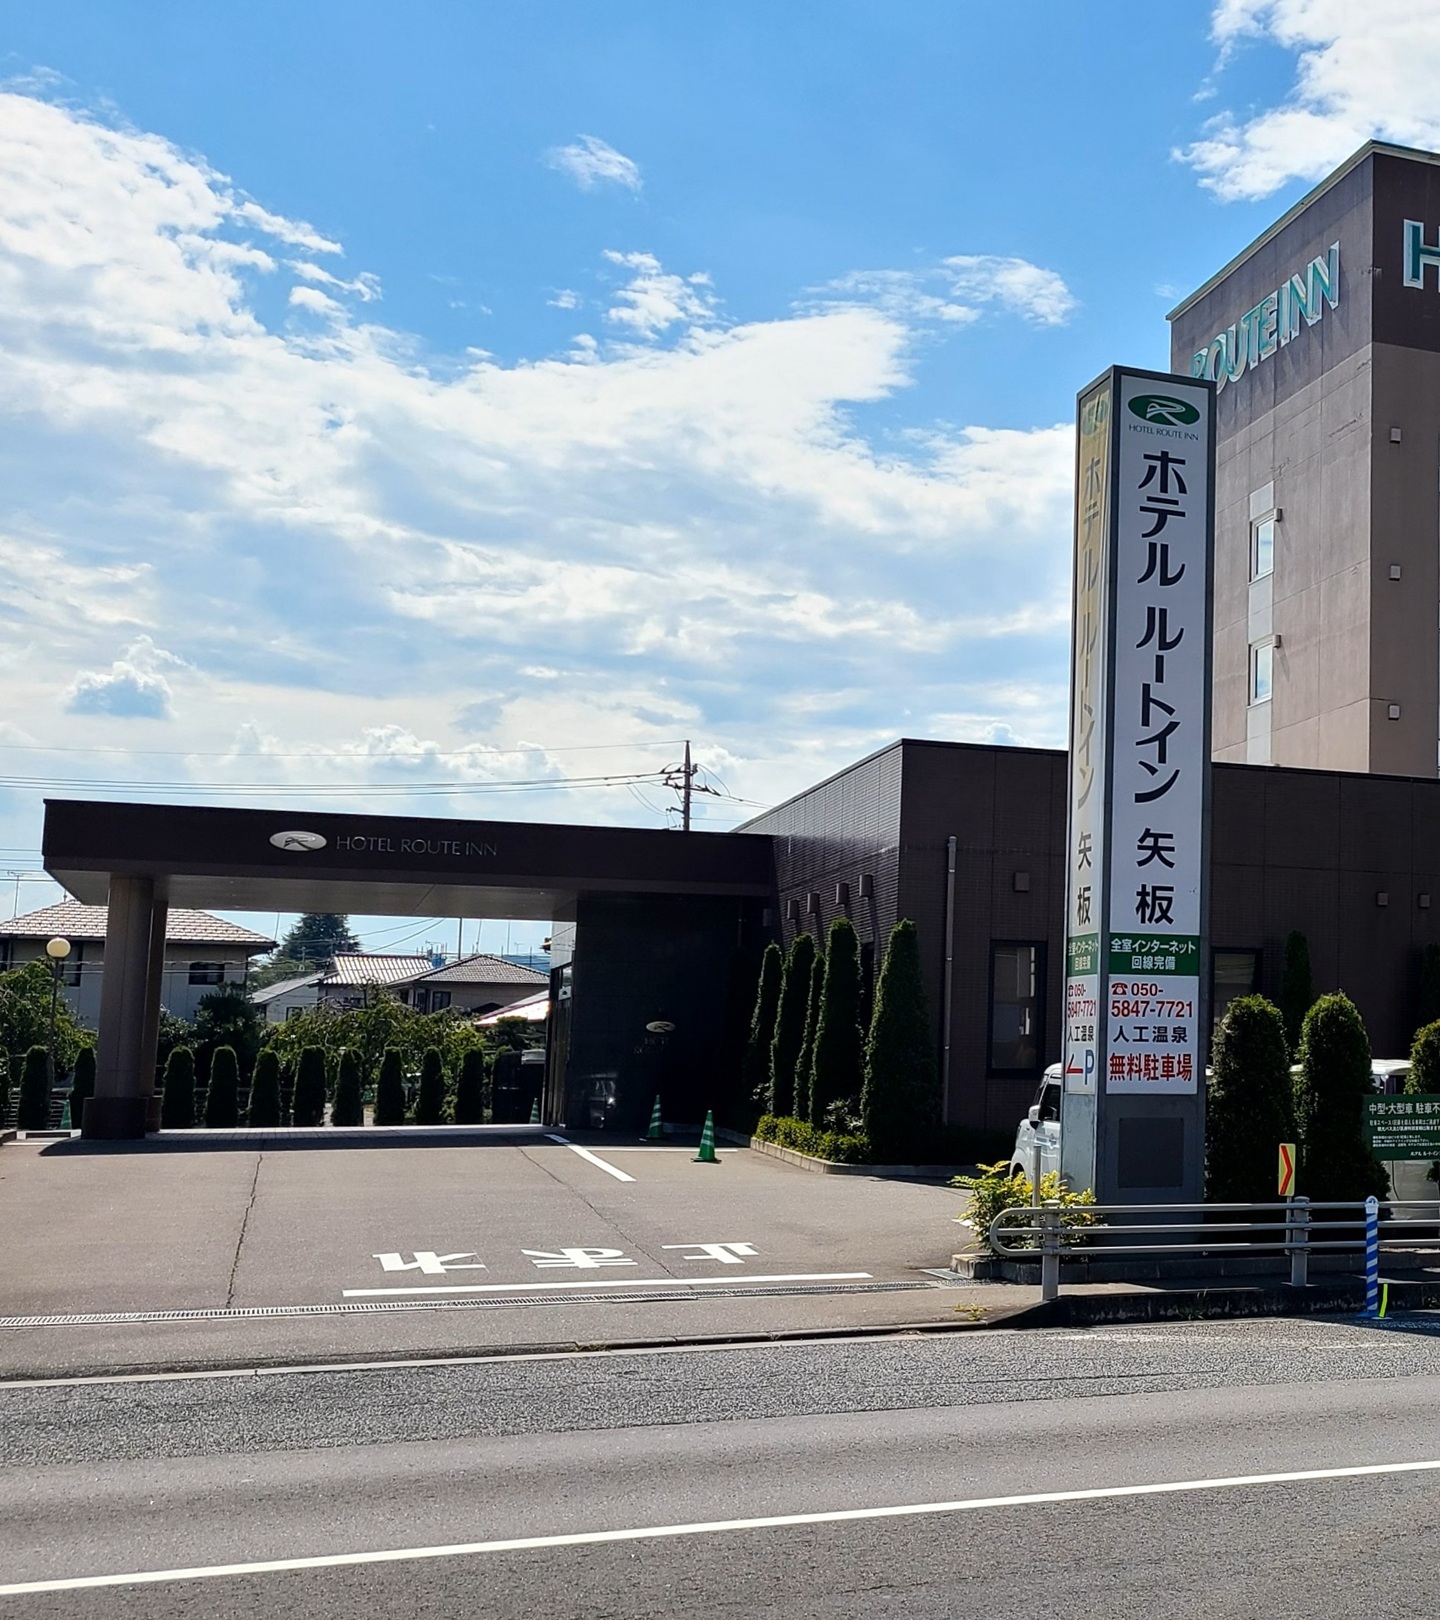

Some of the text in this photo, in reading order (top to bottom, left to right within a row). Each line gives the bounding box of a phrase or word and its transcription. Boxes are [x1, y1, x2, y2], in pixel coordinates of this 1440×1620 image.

[1279, 240, 1339, 348] INN
[1128, 424, 1199, 441] HOTEL ROUTE INN
[1134, 450, 1187, 925] ホテル ルートイン 矢板
[336, 836, 497, 856] HOTEL ROUTE INN
[1077, 831, 1093, 926] 矢板
[1110, 938, 1196, 954] 全室インターネット
[1131, 955, 1176, 970] 回線完備
[1131, 983, 1163, 996] 050-
[1067, 1000, 1096, 1018] 5847-7721
[1111, 1001, 1193, 1018] 5847-7721
[1067, 1025, 1094, 1042] 人工温泉
[1113, 1026, 1188, 1043] 人工温泉
[1084, 1049, 1095, 1085] P
[1109, 1053, 1193, 1081] 無料駐車場
